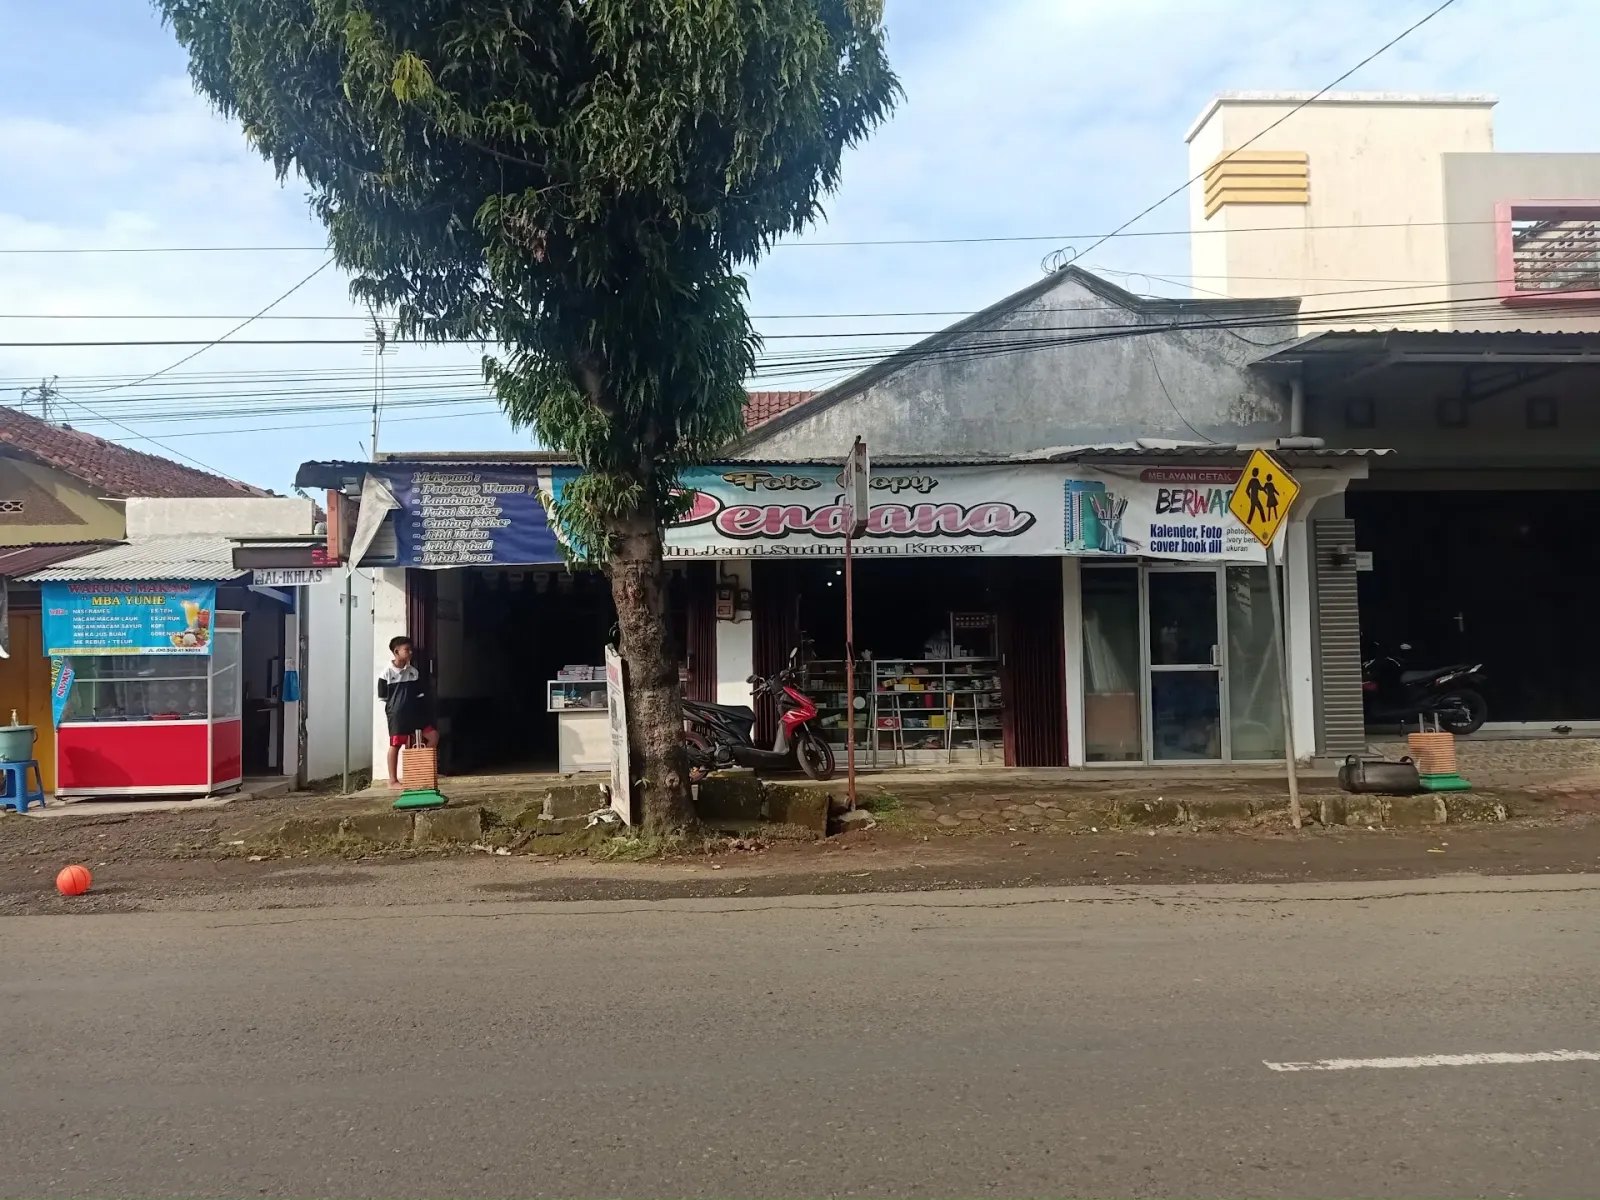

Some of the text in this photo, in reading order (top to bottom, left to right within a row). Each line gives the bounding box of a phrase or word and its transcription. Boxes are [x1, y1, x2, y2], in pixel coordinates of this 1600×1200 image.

[722, 471, 822, 491] Foto
[1147, 472, 1232, 481] MELAYANI CETAK
[482, 482, 525, 494] Warna
[1200, 523, 1222, 539] Foto
[1149, 538, 1222, 554] cover book dll
[265, 569, 323, 585] AL-IKHLAS
[68, 582, 190, 594] WARUNG MAKAN
[92, 595, 166, 606] MBA YUNIE
